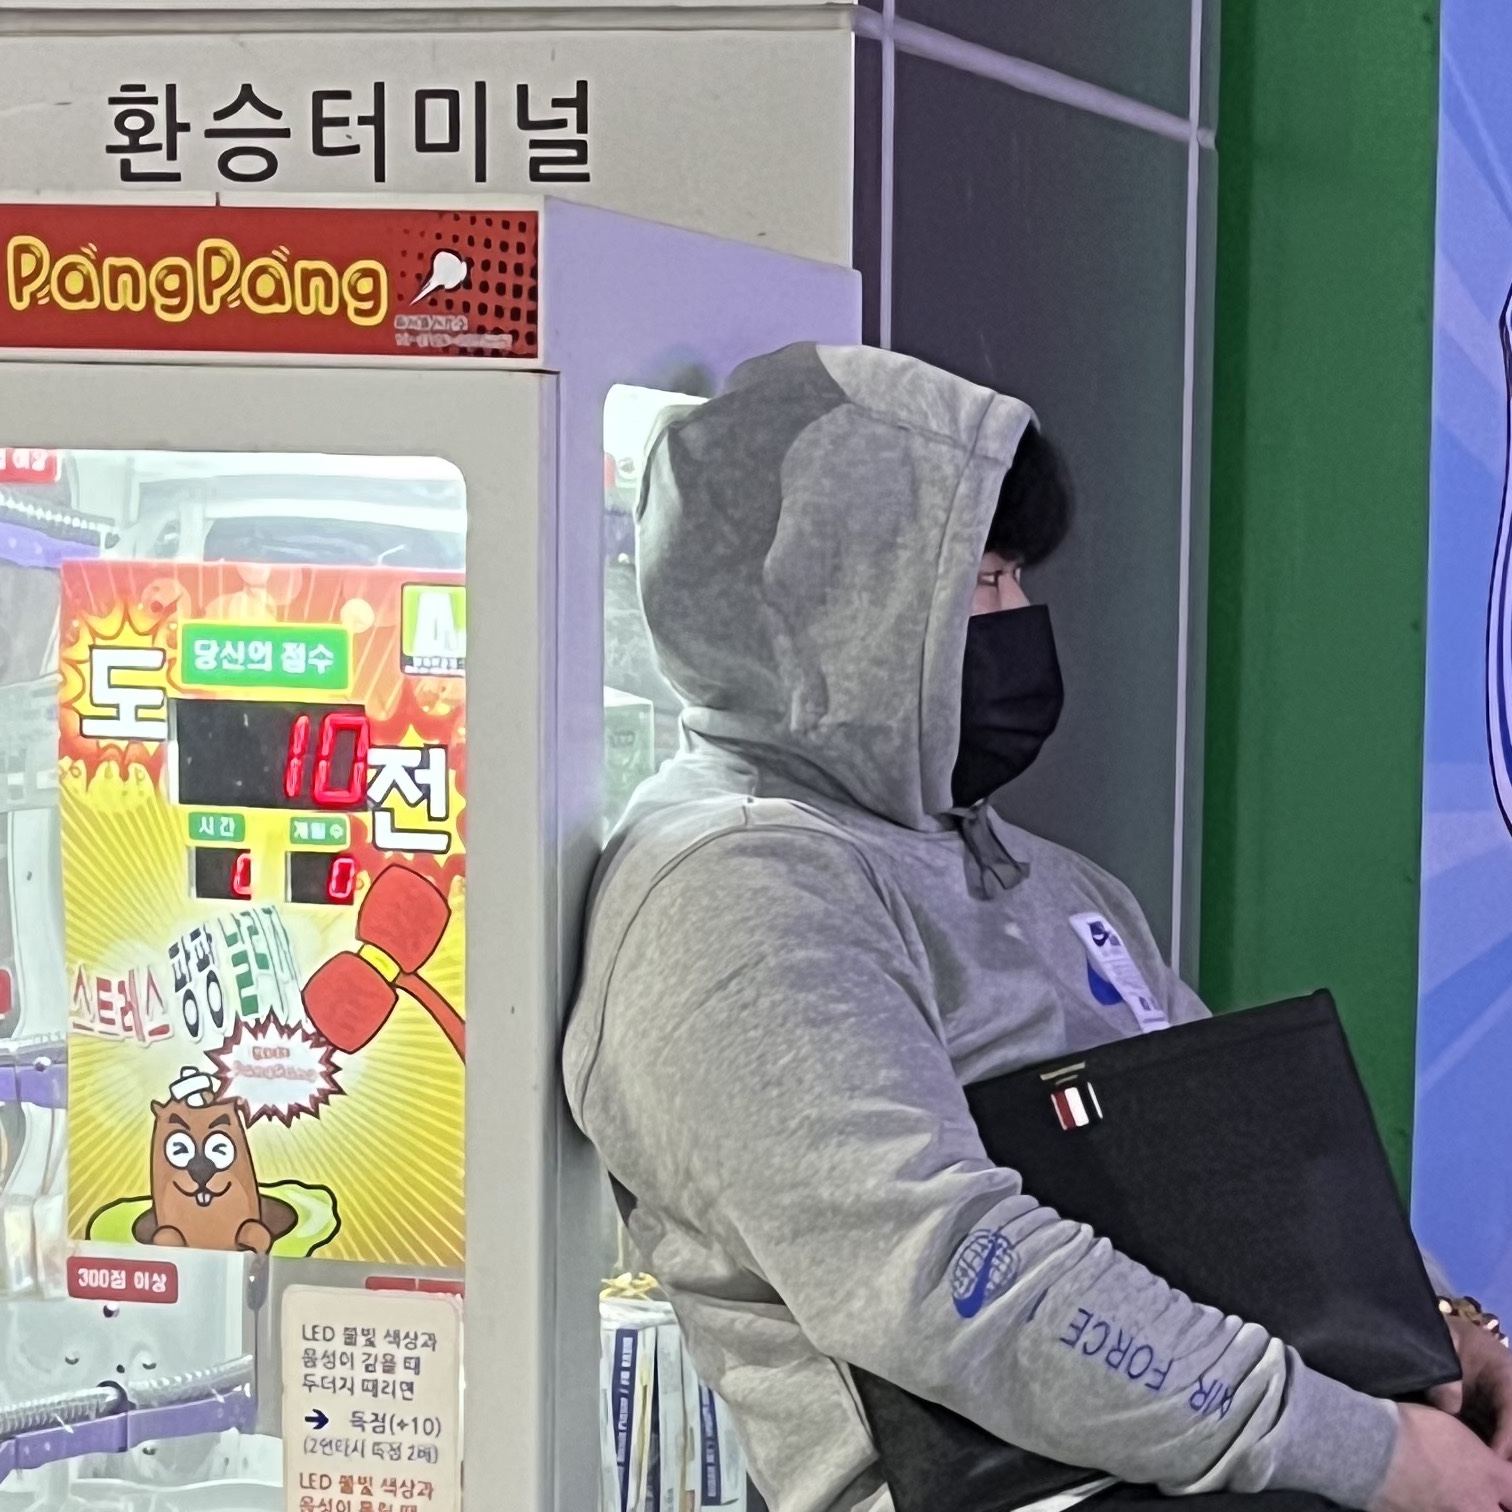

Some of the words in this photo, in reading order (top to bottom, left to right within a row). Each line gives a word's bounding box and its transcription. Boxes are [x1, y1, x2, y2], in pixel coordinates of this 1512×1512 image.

[105, 80, 591, 183] 환승터미널
[6, 235, 388, 326] PangPang
[194, 639, 273, 672] 당신의
[280, 641, 334, 675] 점수
[285, 713, 369, 804] 10
[328, 857, 355, 899] 0
[72, 964, 171, 1042] 스트레스
[78, 1267, 126, 1289] 300점
[134, 1271, 167, 1292] 이상
[302, 1324, 336, 1342] LED
[383, 1328, 437, 1351] 색상과
[1060, 1308, 1174, 1390] FORCE
[302, 1348, 354, 1370] 음성이
[302, 1374, 354, 1396] 두더지
[361, 1378, 415, 1401] 때리면
[1189, 1376, 1234, 1420] AIR
[350, 1410, 442, 1437] 득점(+10)
[299, 1472, 332, 1490] LED
[381, 1477, 434, 1500] 색상과
